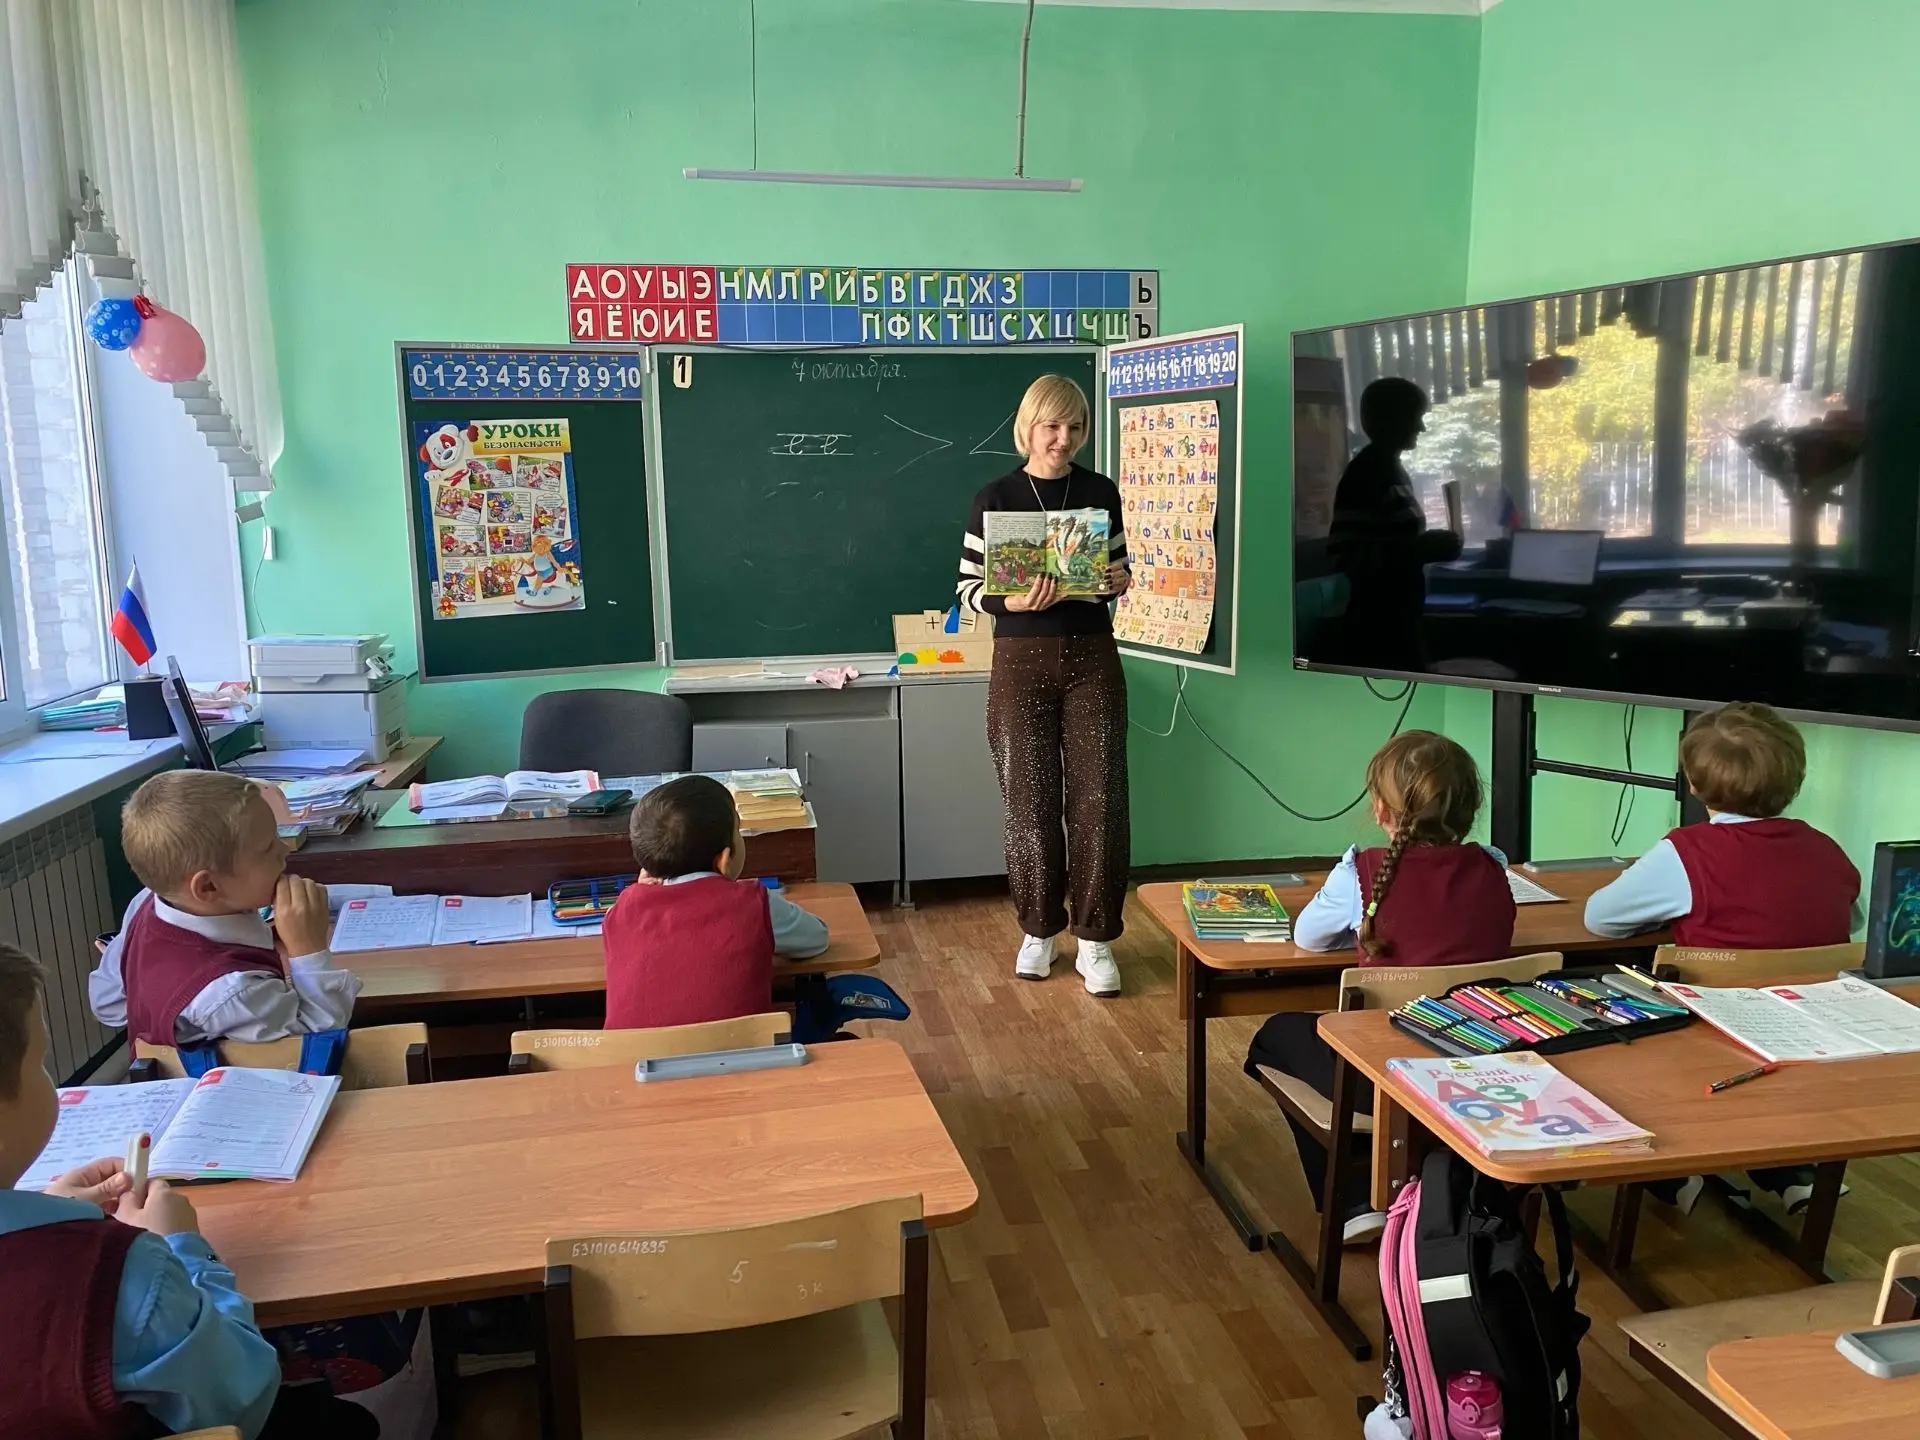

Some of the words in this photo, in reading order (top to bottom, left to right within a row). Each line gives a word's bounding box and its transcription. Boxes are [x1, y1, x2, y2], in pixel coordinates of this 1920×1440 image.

[413, 364, 427, 387] 0
[433, 364, 445, 387] 1
[453, 364, 468, 387] 2
[475, 365, 489, 387] 3
[496, 365, 510, 387] 4
[517, 365, 530, 387] 5
[538, 366, 552, 388] 6
[557, 366, 570, 387] 7
[577, 366, 590, 388] 8
[597, 366, 610, 388] 9
[616, 366, 640, 388] 10
[678, 356, 686, 383] 1
[1111, 366, 1120, 385] 11
[1121, 365, 1132, 384] 12
[1133, 363, 1144, 382] 13
[1145, 361, 1156, 381] 14
[1156, 359, 1168, 380] 15
[1168, 358, 1180, 378] 16
[1181, 356, 1192, 377] 17
[1193, 355, 1206, 375] 18
[1207, 352, 1221, 374] 19
[1222, 350, 1236, 372] 20
[482, 423, 560, 439] УРОКИ
[483, 440, 562, 449] БЕЗОПАСНОСТИ
[1426, 1068, 1510, 1081] Русский
[729, 1260, 749, 1283] 5
